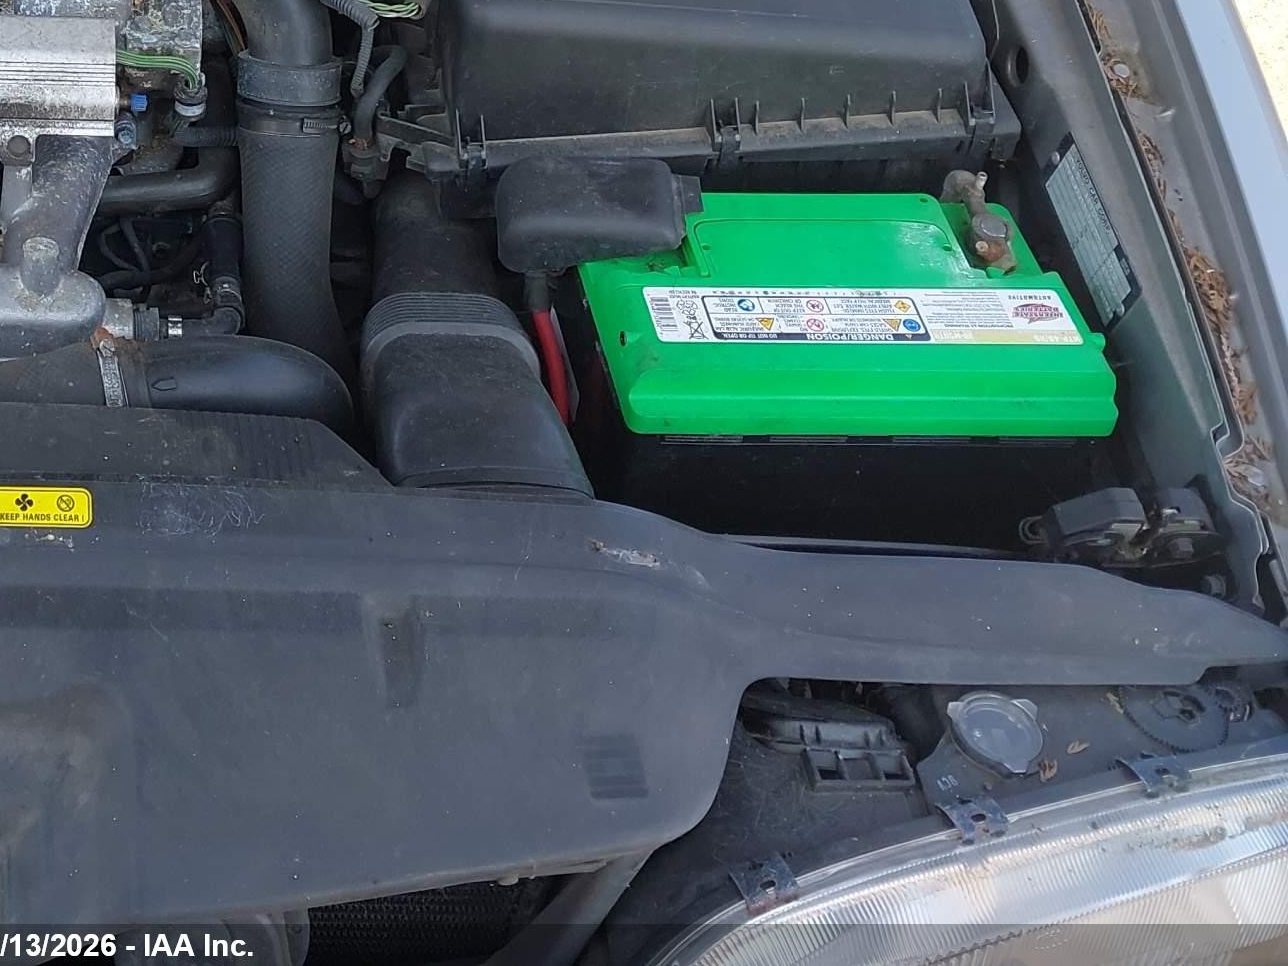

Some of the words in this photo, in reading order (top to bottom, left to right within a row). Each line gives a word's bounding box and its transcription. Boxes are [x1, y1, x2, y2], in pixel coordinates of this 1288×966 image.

[0, 512, 21, 521] KEEP
[23, 513, 51, 521] HANDS
[53, 513, 80, 522] CLEAR
